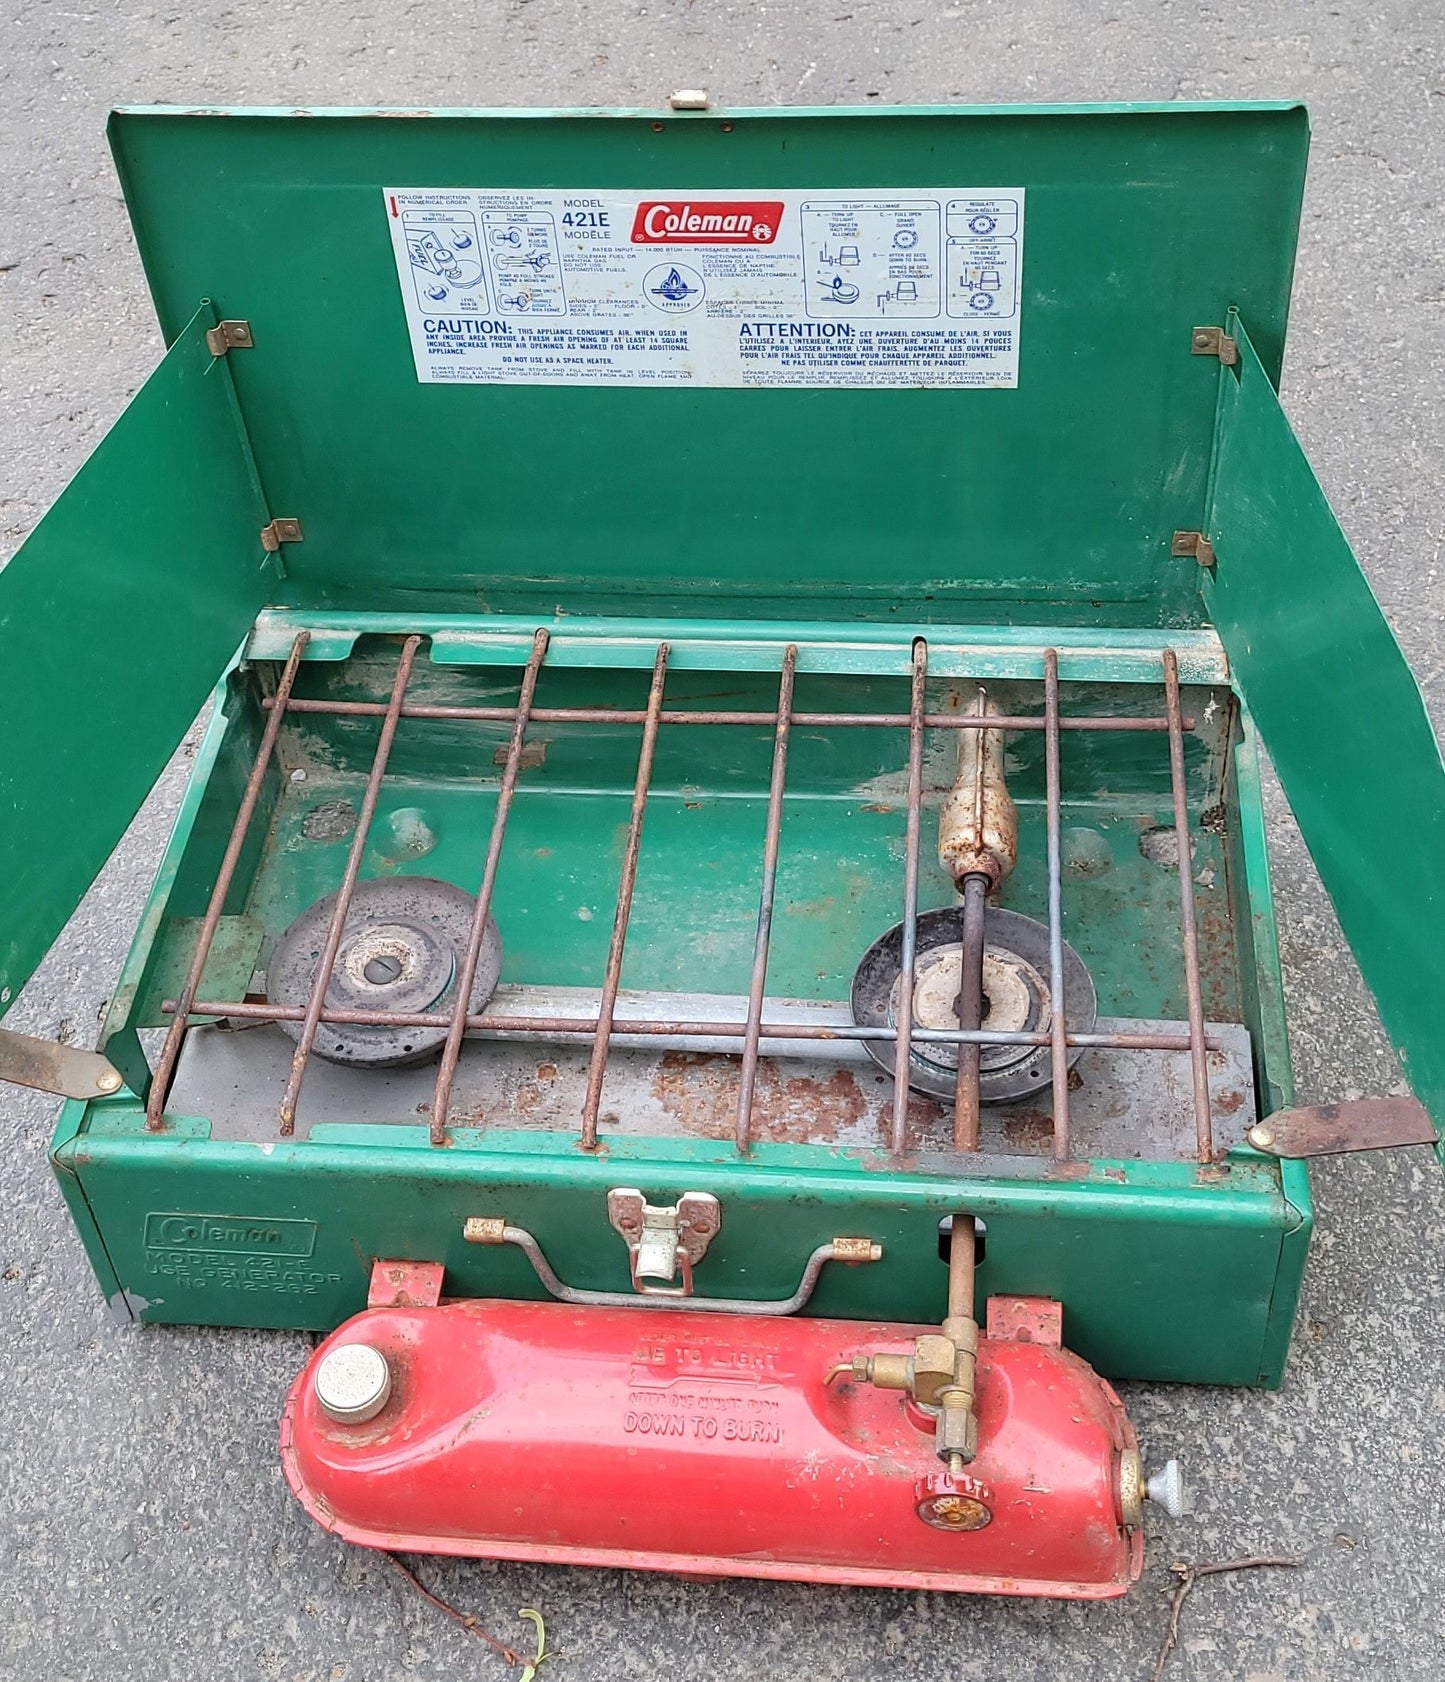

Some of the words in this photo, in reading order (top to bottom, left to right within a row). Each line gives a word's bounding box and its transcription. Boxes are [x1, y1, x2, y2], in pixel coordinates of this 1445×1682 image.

[562, 212, 610, 226] 421E
[644, 205, 753, 238] Coleman
[424, 319, 512, 334] CAUTION:
[536, 328, 574, 336] APPLIANCE
[740, 323, 855, 337] ATTENTION:
[161, 1217, 283, 1243] Coleman
[624, 1411, 685, 1436] DOWN
[691, 1416, 718, 1438] TO
[723, 1418, 781, 1444] BURN
